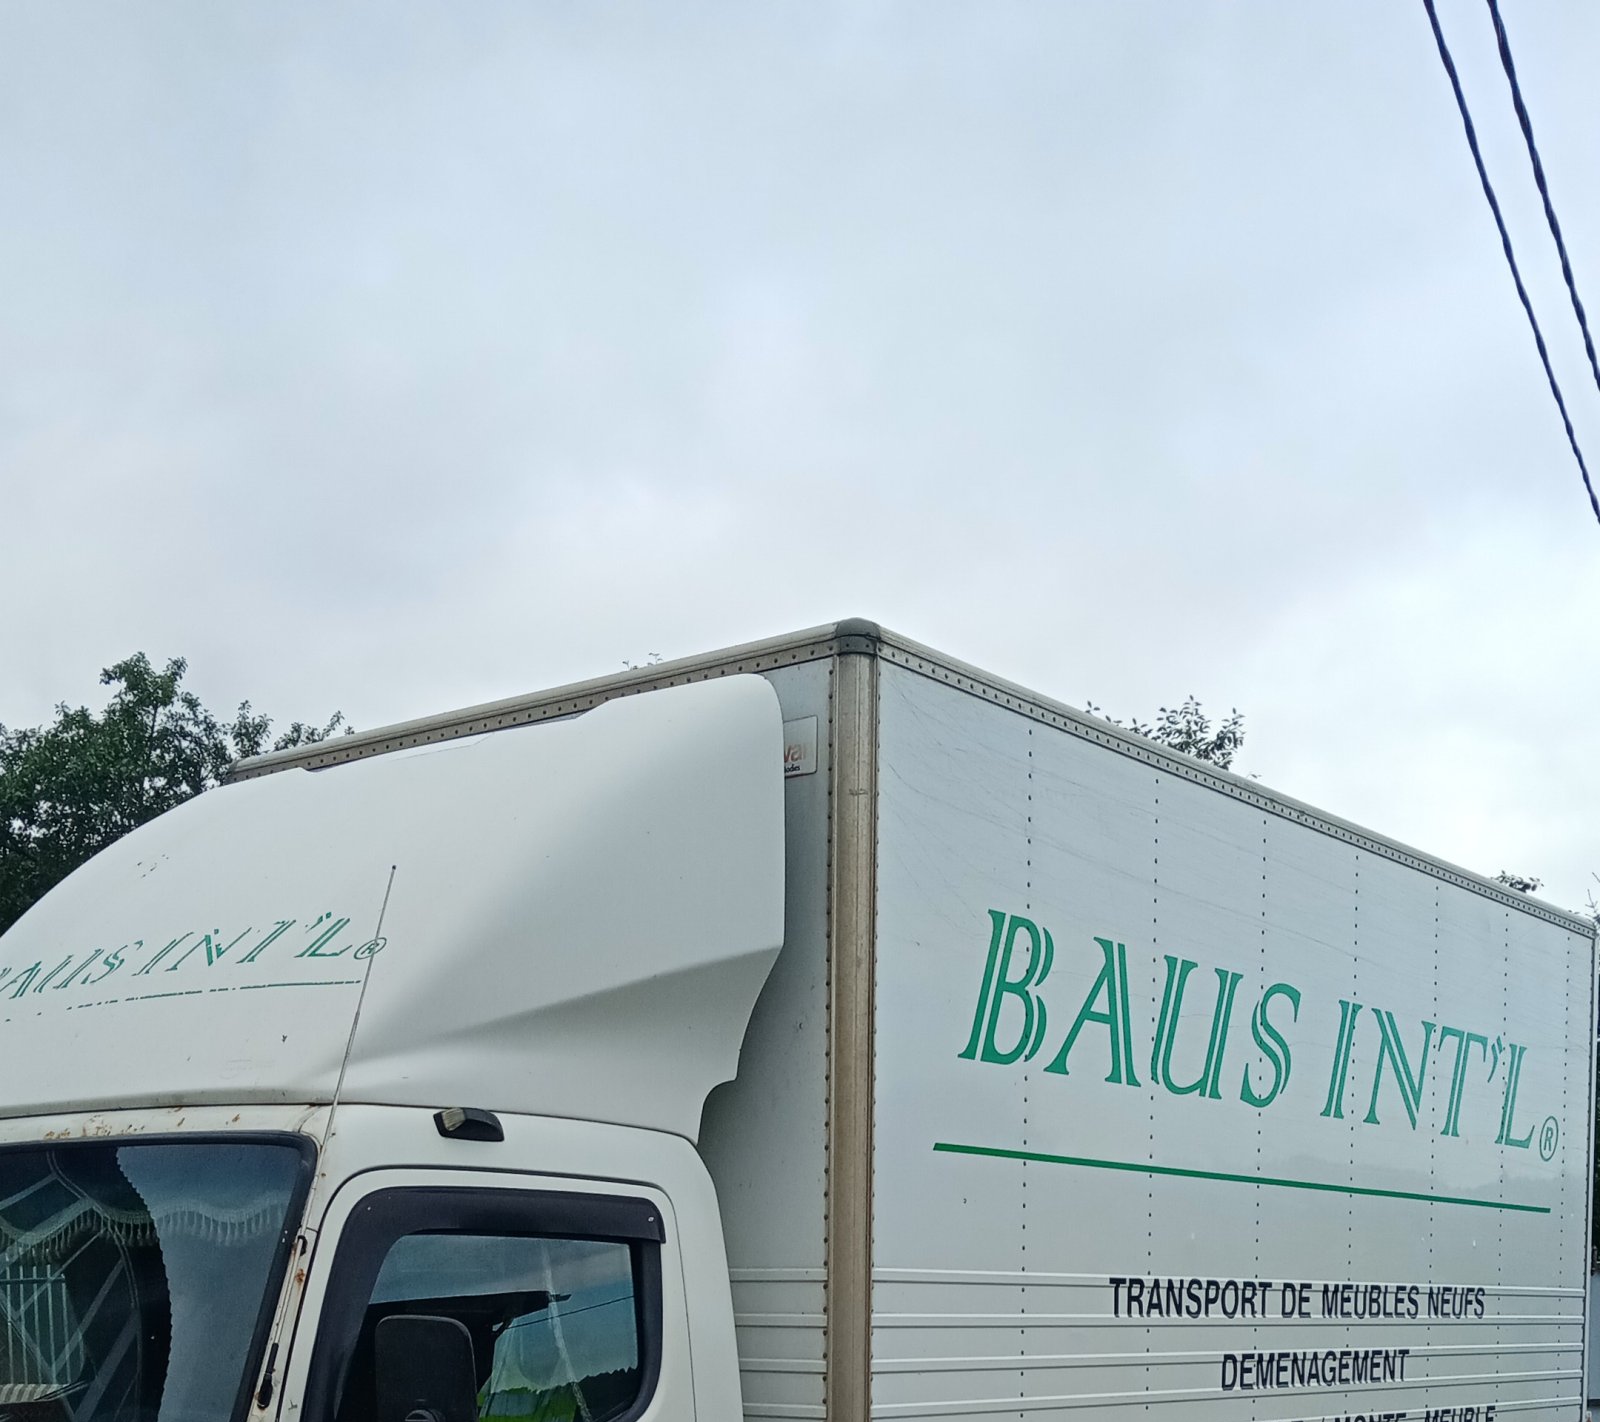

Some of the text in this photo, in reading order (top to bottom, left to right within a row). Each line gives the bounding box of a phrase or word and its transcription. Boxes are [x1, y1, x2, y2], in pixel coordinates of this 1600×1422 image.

[0, 939, 144, 1000] AUS
[957, 908, 1302, 1108] BAUS
[1109, 1277, 1486, 1320] TRANSPORT DE MEUBLES NEUFS
[1221, 1349, 1410, 1391] DEMENAGEMENT
